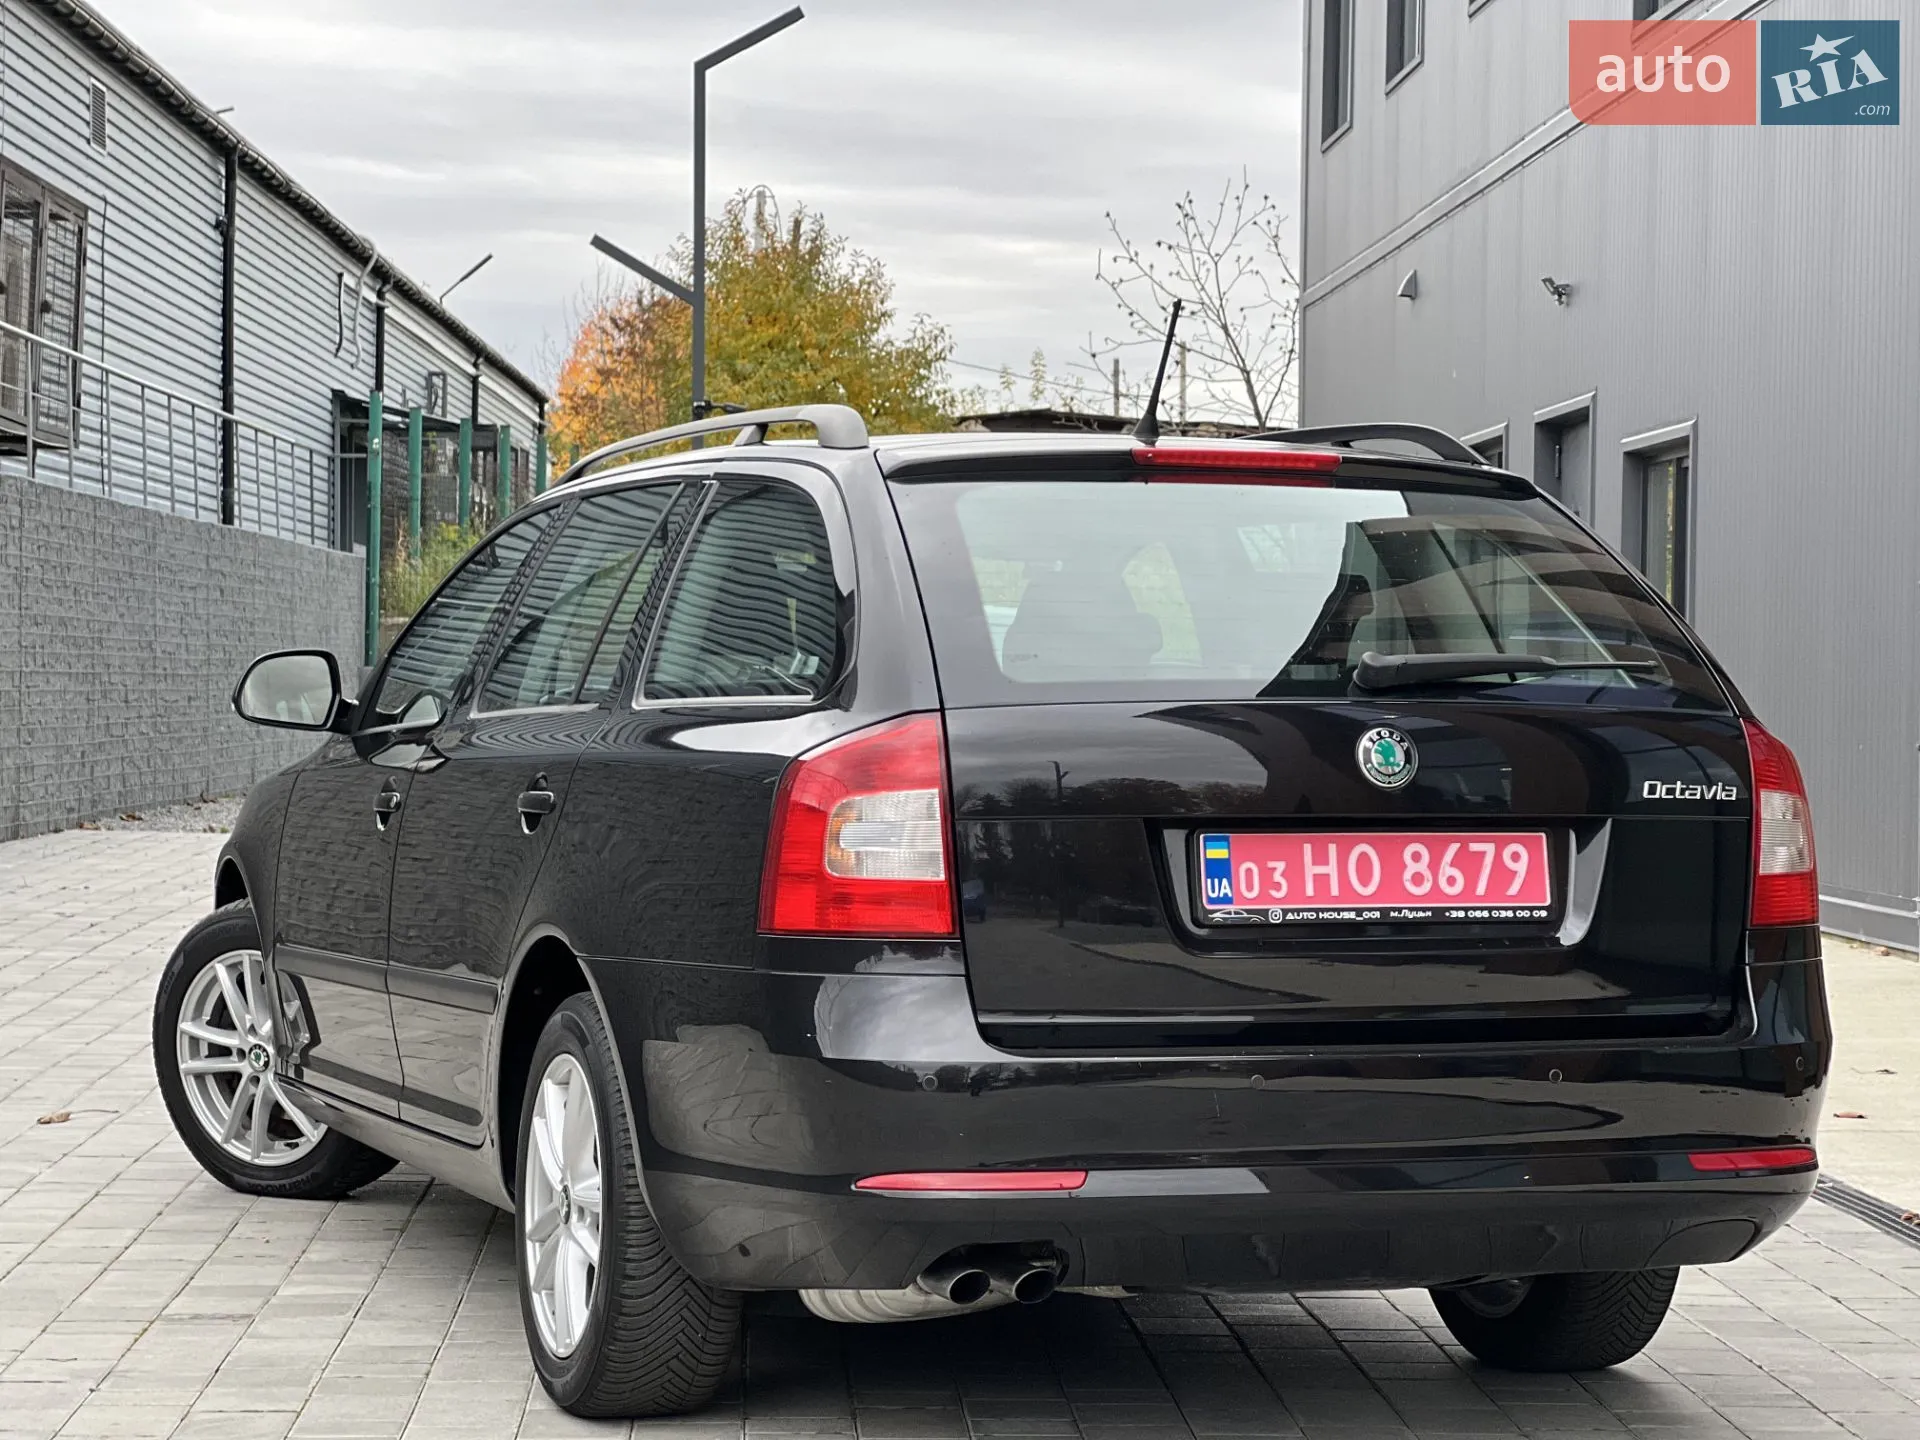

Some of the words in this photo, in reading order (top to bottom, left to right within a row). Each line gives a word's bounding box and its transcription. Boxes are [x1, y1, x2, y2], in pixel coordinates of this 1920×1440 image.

[1642, 780, 1737, 801] Octavia
[1238, 861, 1289, 899] 03
[1303, 842, 1382, 897] HO
[1402, 842, 1529, 896] 8679
[1206, 877, 1232, 898] UA
[1285, 911, 1316, 920] AUTO
[1319, 910, 1380, 921] HOUSE_001
[1444, 909, 1466, 918] +38
[1467, 909, 1490, 918] 066
[1515, 909, 1531, 918] 00
[1532, 909, 1548, 918] 09
